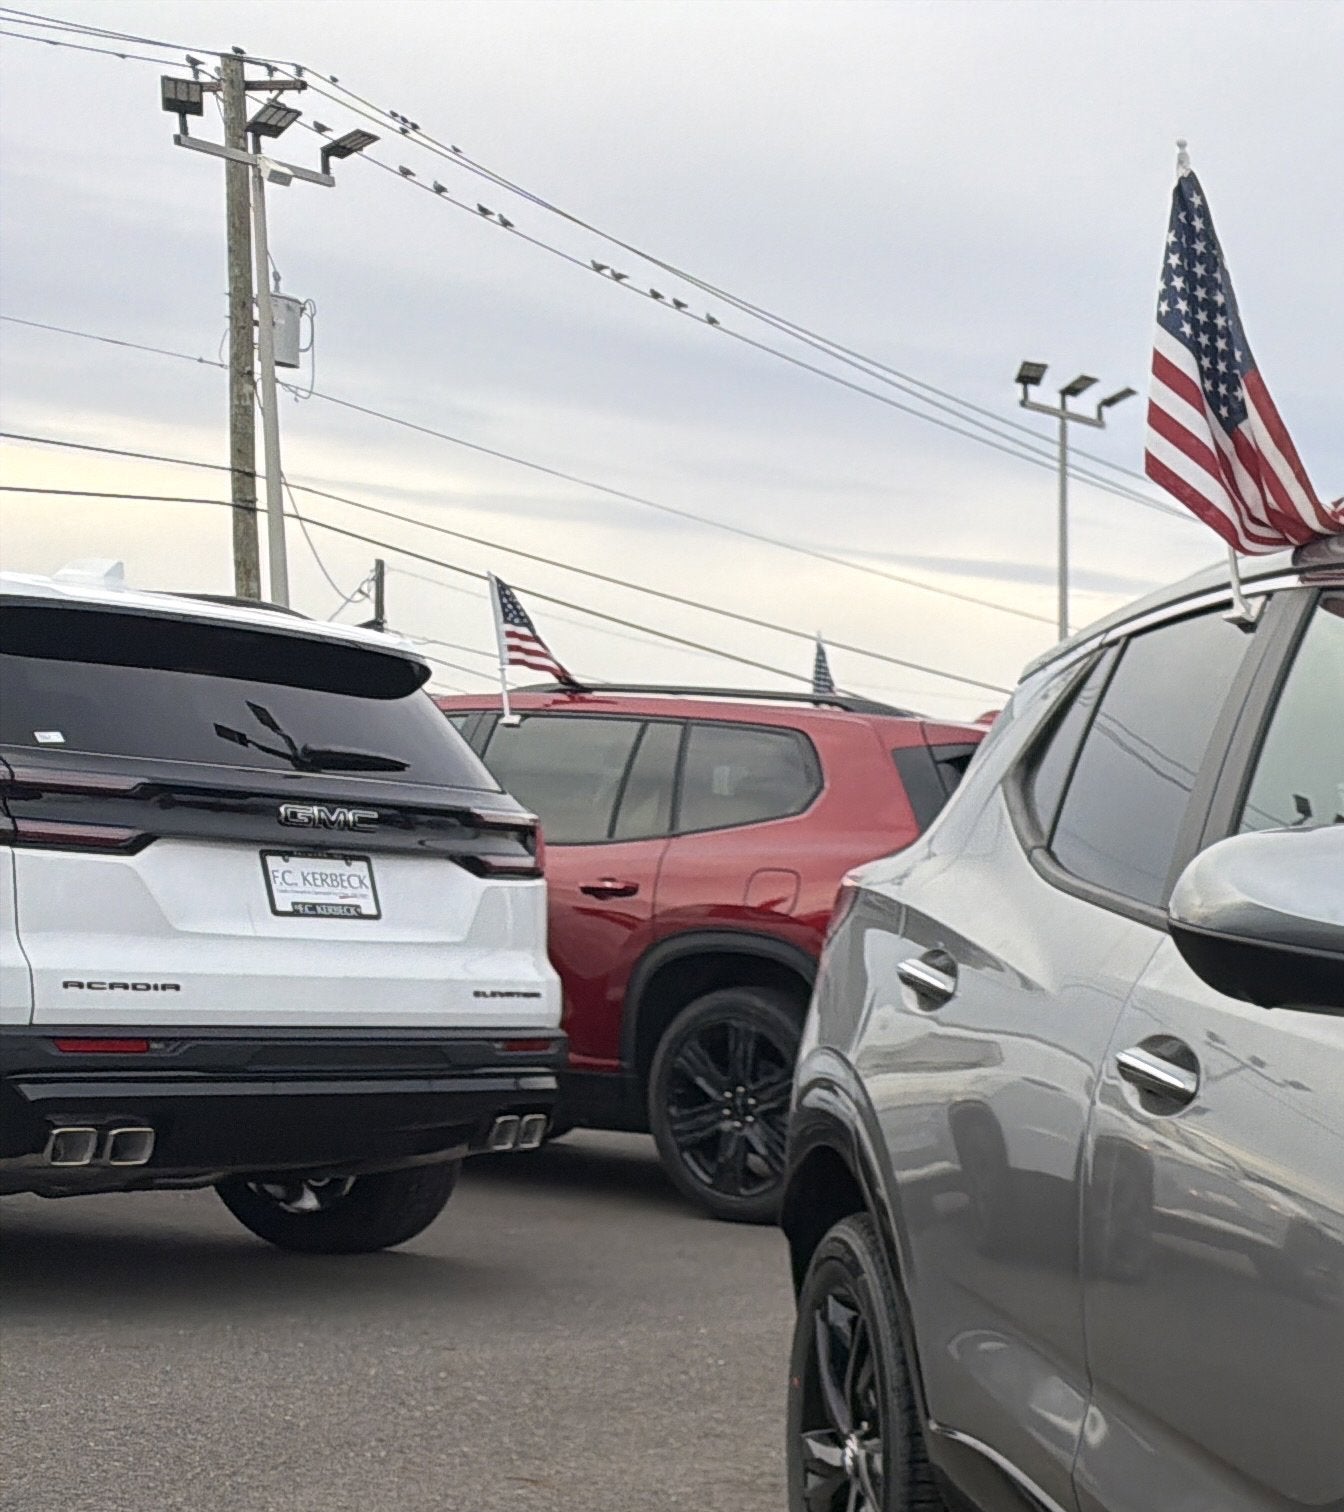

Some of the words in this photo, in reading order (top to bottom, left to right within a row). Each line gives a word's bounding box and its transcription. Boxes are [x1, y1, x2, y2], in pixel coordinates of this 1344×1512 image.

[278, 803, 380, 833] GMC
[301, 870, 369, 891] KERBECK
[62, 980, 181, 992] ACADIA
